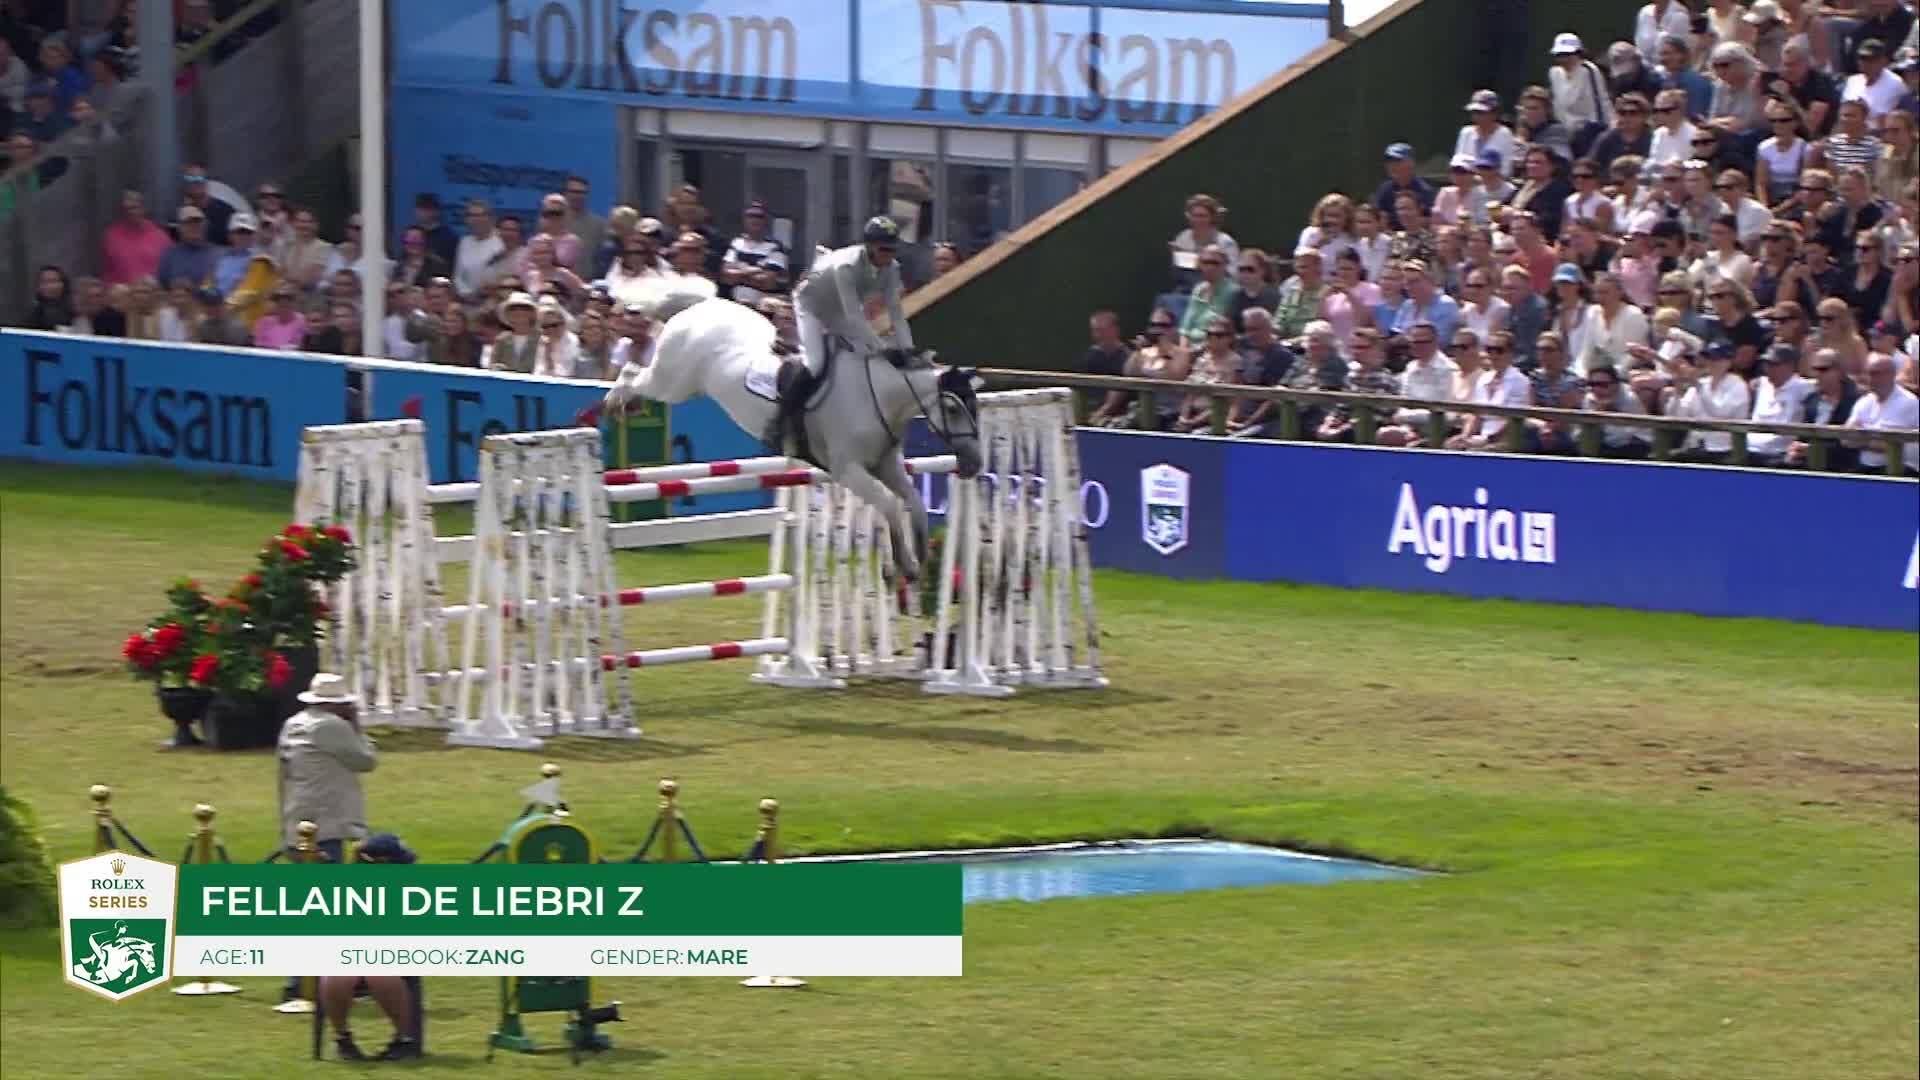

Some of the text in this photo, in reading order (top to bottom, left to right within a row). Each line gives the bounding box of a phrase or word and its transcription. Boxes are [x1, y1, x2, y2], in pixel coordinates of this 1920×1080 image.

[489, 0, 796, 101] Folksam
[912, 0, 1237, 124] Folksam
[23, 348, 273, 468] Folksam
[1388, 483, 1518, 573] Agria
